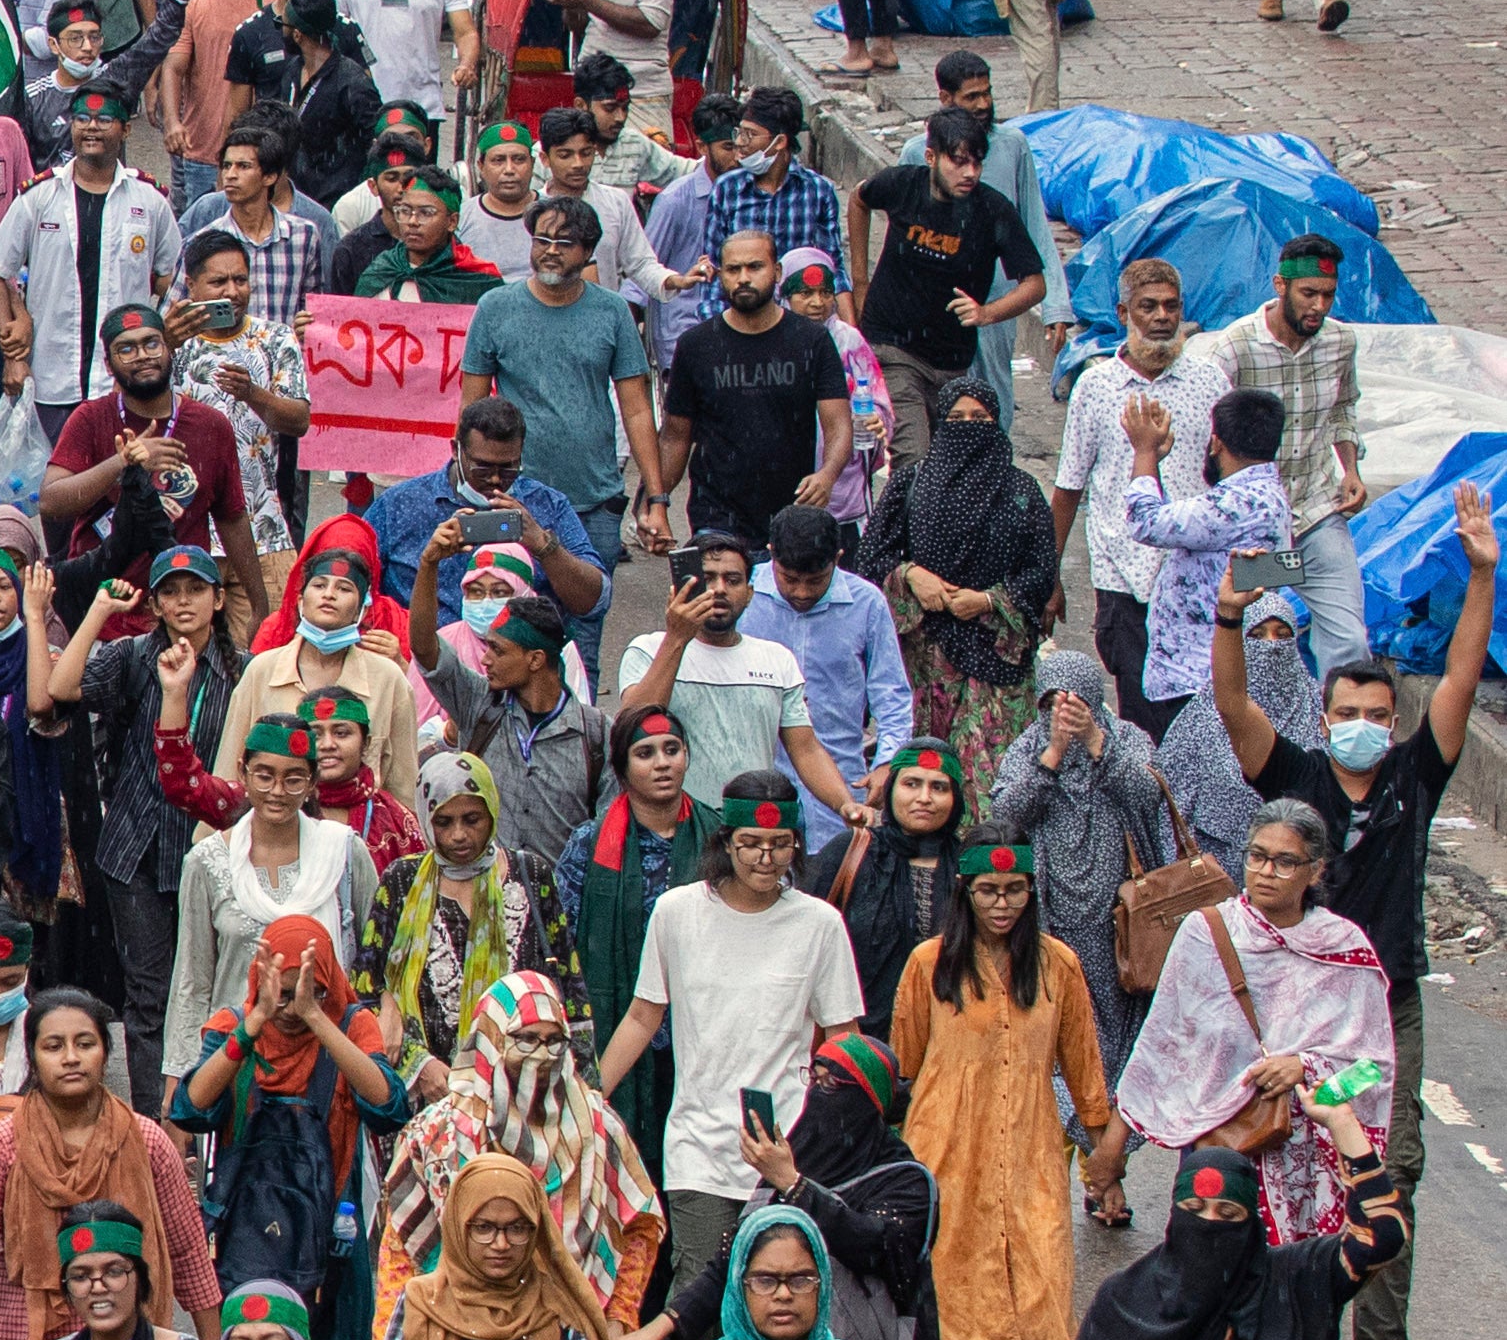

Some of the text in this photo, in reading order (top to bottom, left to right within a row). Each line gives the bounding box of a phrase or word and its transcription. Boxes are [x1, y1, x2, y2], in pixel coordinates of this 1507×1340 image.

[306, 318, 425, 389] এক
[714, 361, 797, 389] MILANO
[748, 670, 774, 680] BLACK
